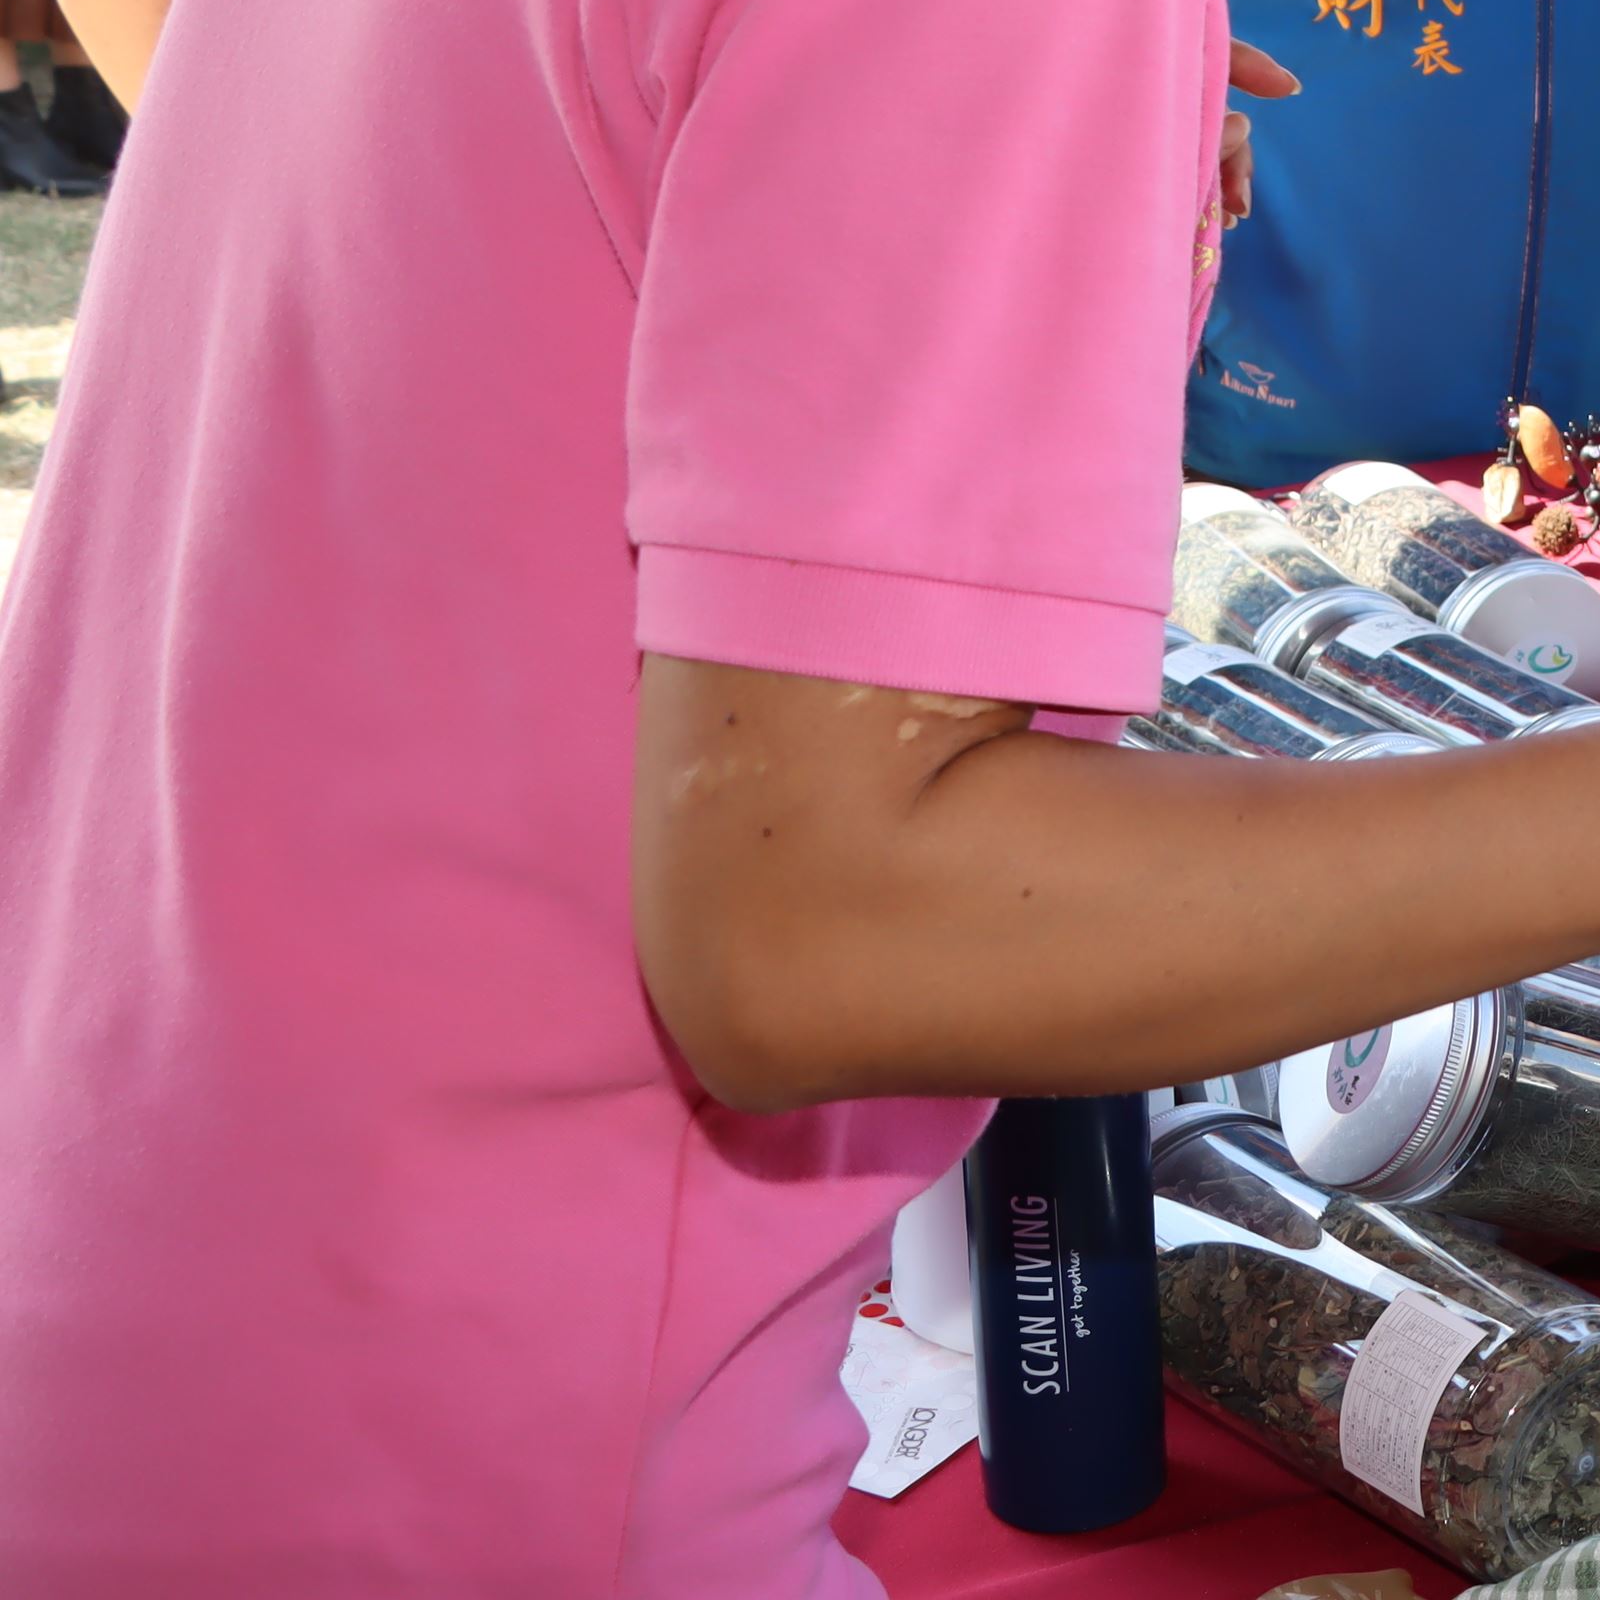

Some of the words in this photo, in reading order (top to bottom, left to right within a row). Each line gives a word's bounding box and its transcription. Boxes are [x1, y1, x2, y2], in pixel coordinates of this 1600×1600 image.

[1010, 1195, 1054, 1302] LIVING
[1067, 1248, 1088, 1311] together
[1019, 1315, 1061, 1395] SCAN
[1070, 1314, 1091, 1338] get
